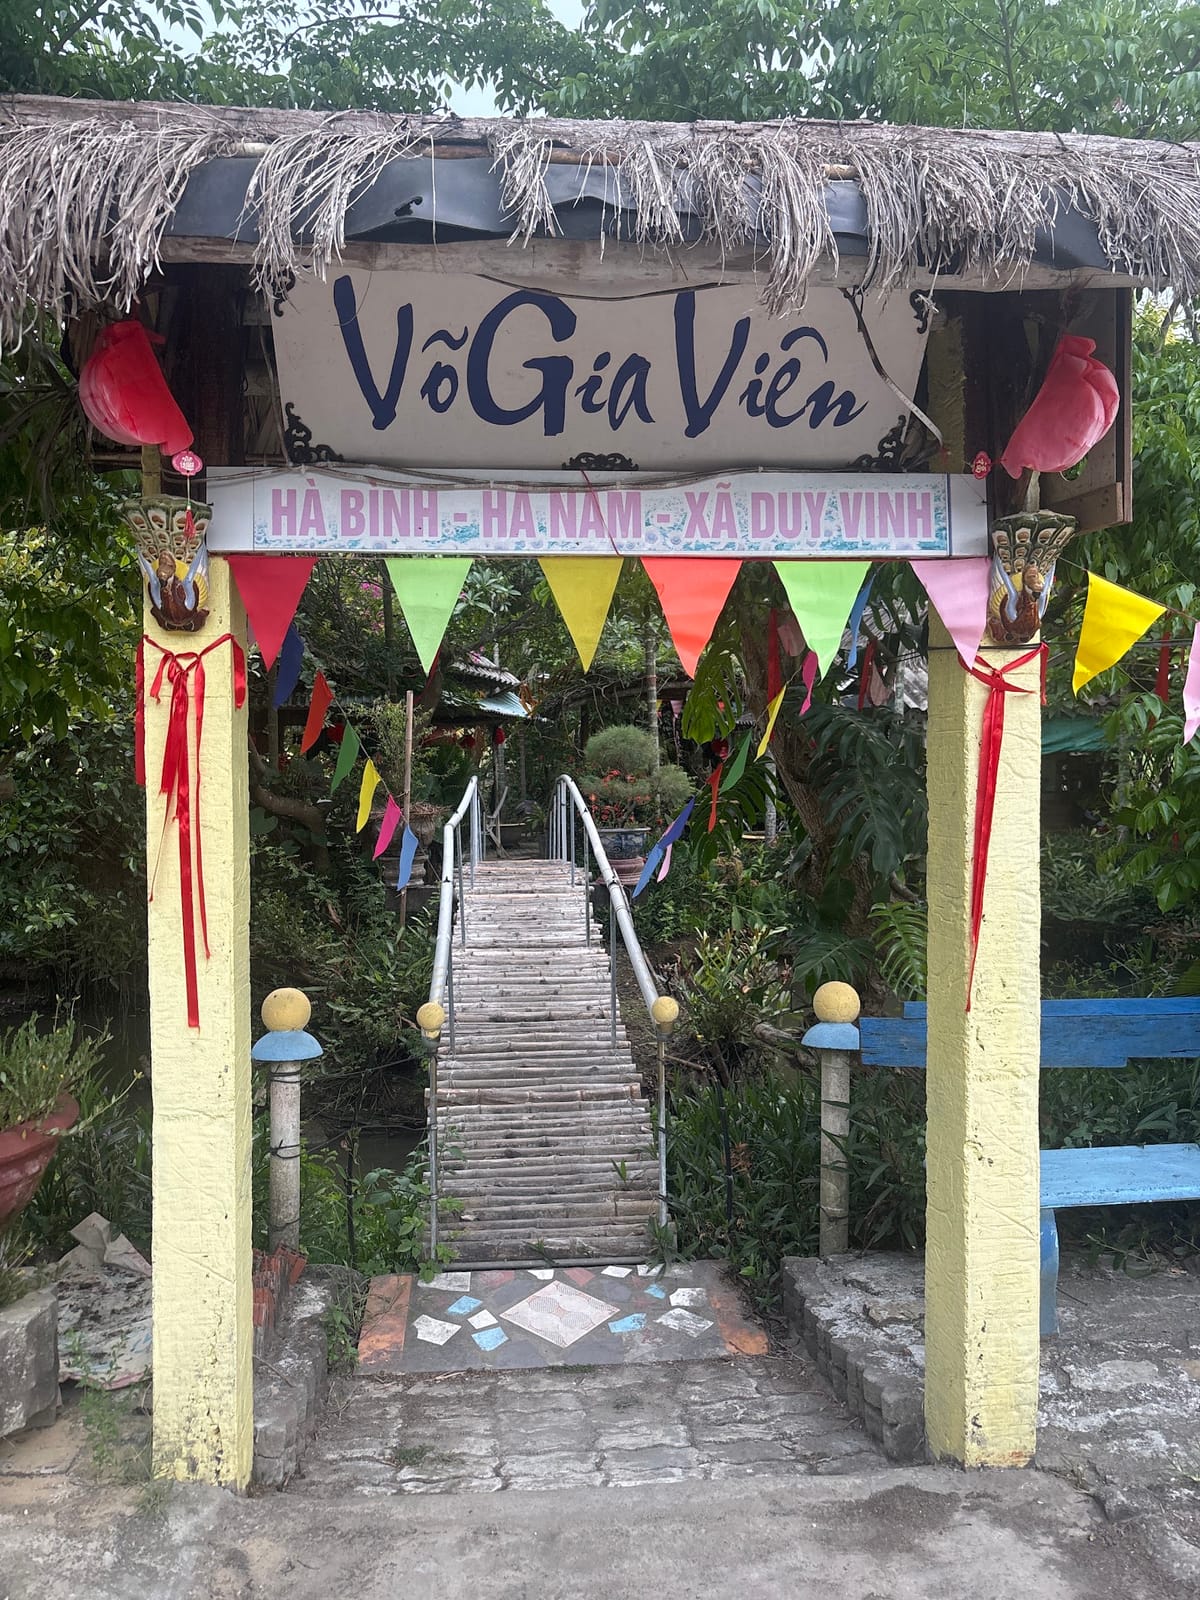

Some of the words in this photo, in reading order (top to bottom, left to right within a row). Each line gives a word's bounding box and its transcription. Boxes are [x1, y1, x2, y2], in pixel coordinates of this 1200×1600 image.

[467, 287, 656, 436] Gia
[673, 290, 869, 438] Viên
[271, 478, 327, 537] HÀ
[340, 478, 438, 537] BÌNH
[550, 490, 642, 538] NAM
[684, 482, 738, 539] XÃ
[751, 491, 827, 539] DUY
[840, 491, 933, 539] VINH
